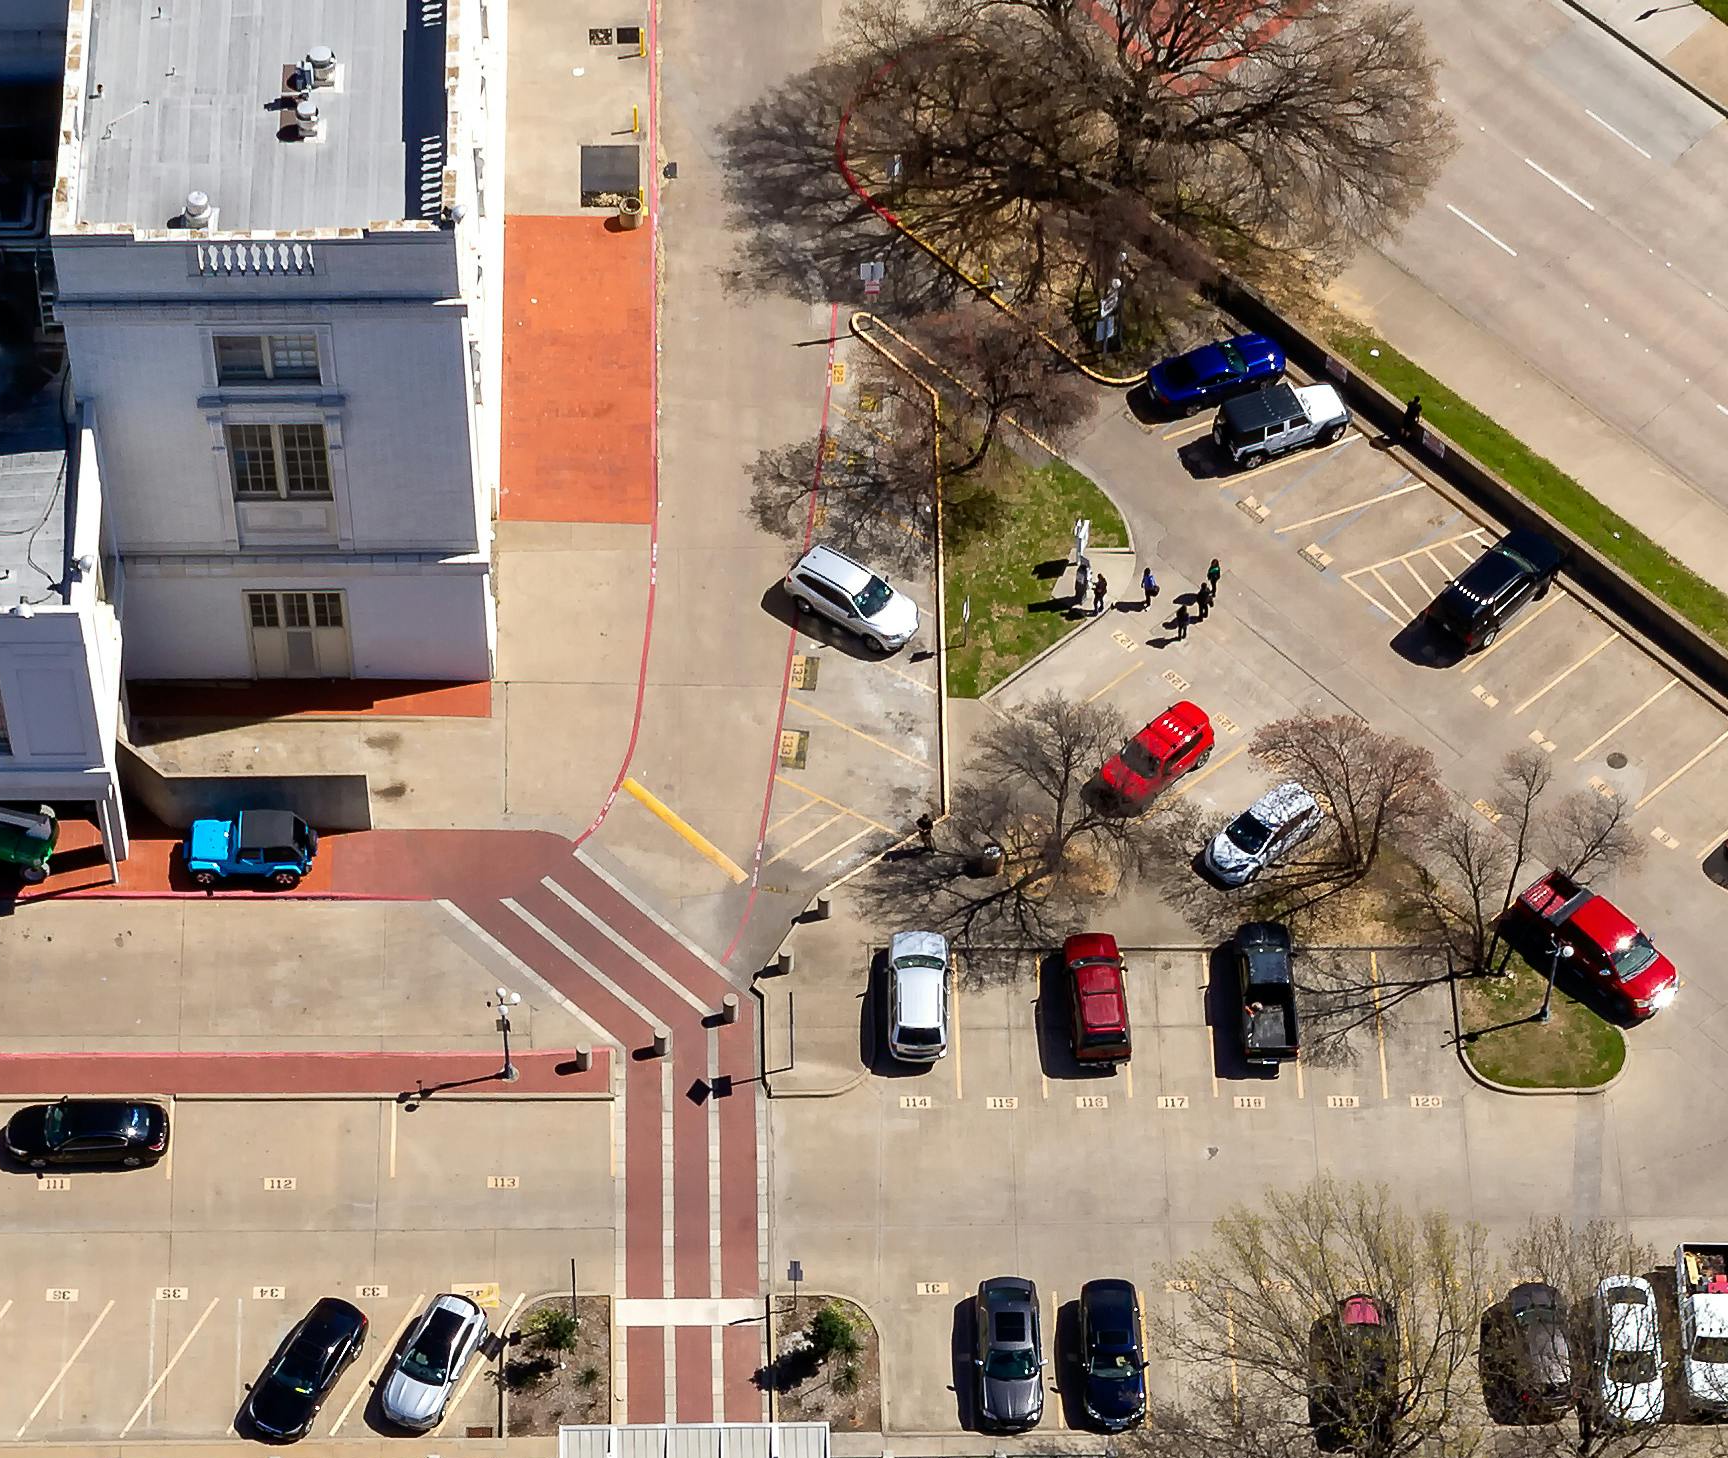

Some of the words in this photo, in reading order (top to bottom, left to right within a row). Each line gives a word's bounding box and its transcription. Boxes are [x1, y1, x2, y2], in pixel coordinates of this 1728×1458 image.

[1113, 632, 1134, 649] 127
[792, 663, 804, 682] 132
[781, 735, 794, 756] 133
[906, 1097, 927, 1107] 114
[992, 1098, 1014, 1107] 115
[1082, 1097, 1104, 1107] 116
[1164, 1098, 1185, 1107] 117
[1415, 1097, 1440, 1107] 120
[46, 1180, 64, 1189] 111
[270, 1179, 292, 1189] 112
[494, 1177, 516, 1187] 113
[260, 1288, 279, 1298] 34
[362, 1287, 380, 1297] 33
[925, 1283, 940, 1293] 31
[162, 1289, 181, 1299] 35
